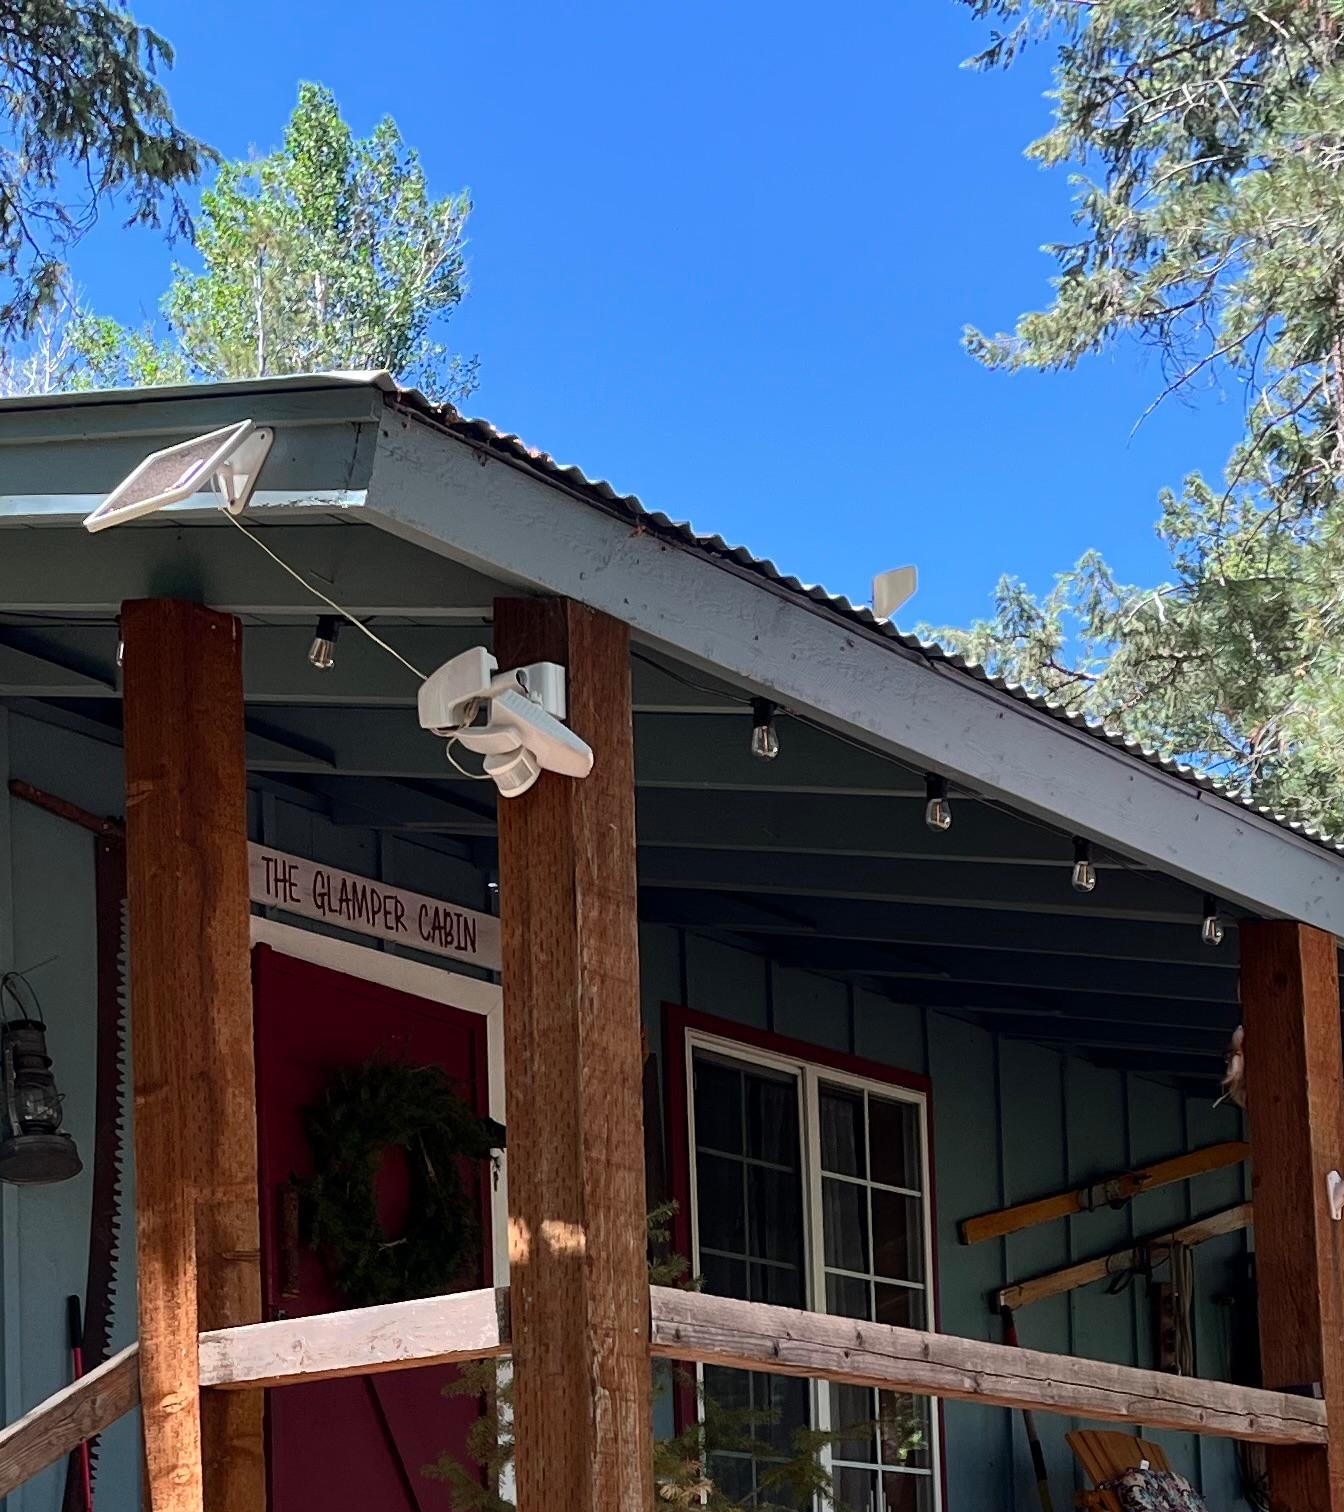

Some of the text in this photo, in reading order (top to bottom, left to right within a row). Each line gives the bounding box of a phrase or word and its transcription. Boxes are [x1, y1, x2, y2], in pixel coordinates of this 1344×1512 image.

[261, 856, 477, 953] THE GLAMPER CABIN
